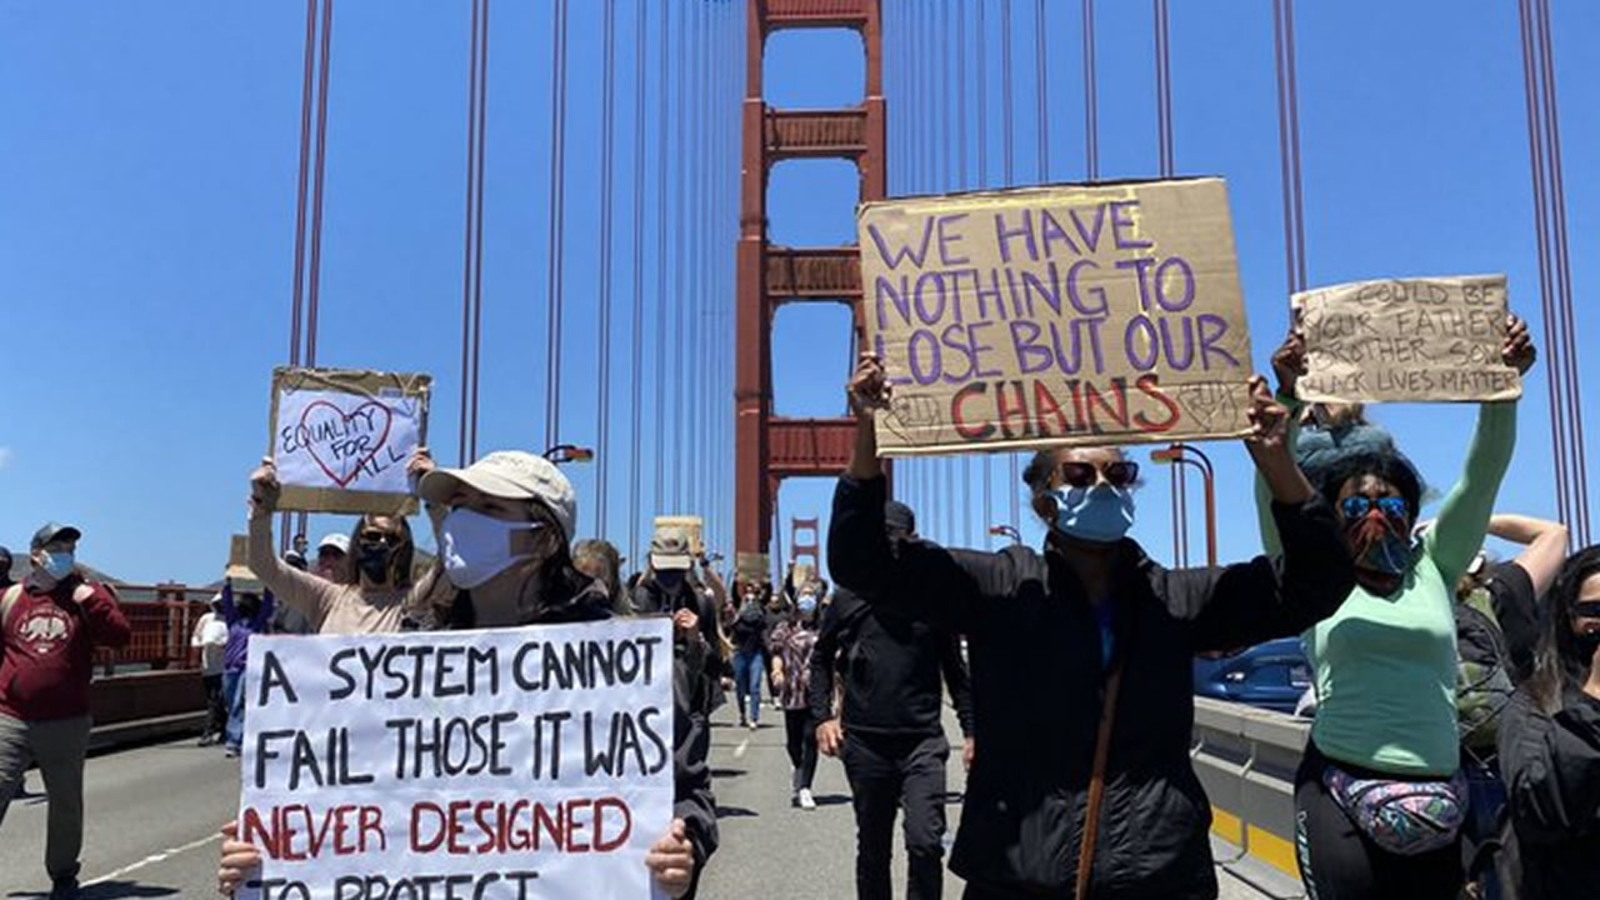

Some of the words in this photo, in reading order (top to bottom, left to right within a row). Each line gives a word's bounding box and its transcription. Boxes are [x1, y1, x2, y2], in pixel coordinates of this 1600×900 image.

[867, 213, 970, 271] WE
[995, 200, 1154, 264] HAVE
[875, 258, 1110, 331] NOTHING
[1115, 255, 1196, 313] TO
[1356, 282, 1449, 308] COULD
[1462, 282, 1505, 306] BE
[874, 320, 1004, 386] LOSE
[1009, 316, 1106, 376] BUT
[1124, 313, 1240, 373] OUR
[1377, 368, 1435, 392] LIVES
[1440, 369, 1517, 393] MATTER
[281, 407, 376, 454] EQUALITY
[951, 372, 1181, 441] CHAINS
[330, 435, 374, 460] FOR
[354, 445, 405, 482] ALL
[258, 650, 299, 707] A
[329, 645, 499, 701] SYSTEM
[512, 636, 663, 692] CANNOT
[255, 727, 375, 791] FAIL
[385, 711, 519, 780] THOSE
[532, 711, 572, 780] IT
[582, 706, 668, 777] WAS
[242, 804, 387, 862] NEVER
[409, 796, 632, 855] DESIGNED
